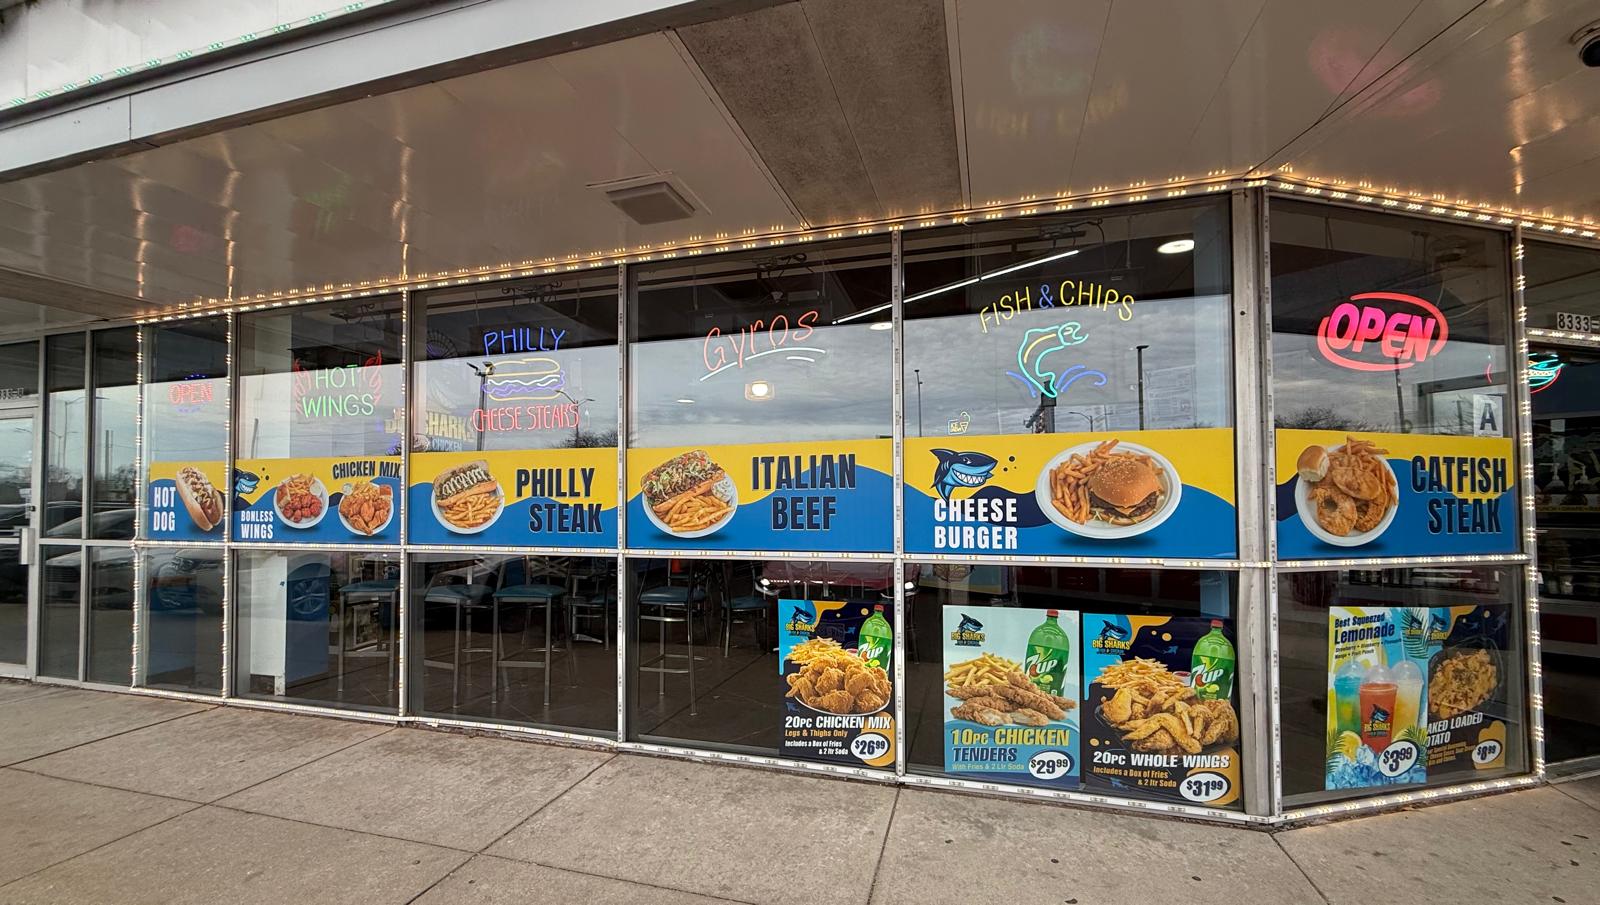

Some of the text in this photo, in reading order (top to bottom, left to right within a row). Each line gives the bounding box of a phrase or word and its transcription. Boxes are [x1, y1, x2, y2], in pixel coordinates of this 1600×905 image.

[980, 280, 1135, 333] FISH & CHIPS
[484, 327, 567, 357] PHILLY
[703, 310, 818, 371] Gyros
[1326, 302, 1436, 362] OPEN
[315, 364, 358, 389] HOT
[169, 383, 213, 405] OPEN
[302, 393, 375, 418] WINGS
[1480, 402, 1498, 431] A
[471, 403, 580, 432] CHEESE STEAKS
[332, 460, 401, 480] CHICKEN MIX
[752, 453, 856, 491] ITALIAN
[1411, 455, 1507, 494] CATFISH
[516, 467, 596, 498] PHILLY
[154, 486, 176, 508] HOT
[241, 510, 274, 522] BONLESS
[528, 503, 604, 534] STEAK
[772, 496, 836, 531] BEEF
[934, 498, 1018, 522] CHEESE
[1428, 498, 1502, 535] STEAK
[153, 511, 176, 532] DOG
[241, 523, 274, 539] WINGS
[934, 525, 1018, 550] BURGER
[1334, 622, 1395, 645] Lemonade
[1335, 617, 1350, 628] Best
[1092, 639, 1130, 651] BIG SHARKS
[785, 716, 892, 730] 20PC CHICKEN MIX
[785, 729, 848, 739] Legs & Thighs Only
[1427, 712, 1483, 735] AKED LOADED
[829, 740, 843, 748] Fries
[952, 728, 1070, 747] 10PC CHICKEN
[1427, 731, 1451, 748] OTATO
[835, 748, 849, 756] Soda
[953, 746, 1018, 762] TENDERS
[1093, 750, 1231, 769] 20PC WHOLE WINGS
[951, 762, 966, 771] With
[967, 762, 984, 771] Fries
[1007, 762, 1024, 771] Soda
[1093, 765, 1169, 779] Includes a Box of Fries
[1159, 779, 1177, 788] Soda
